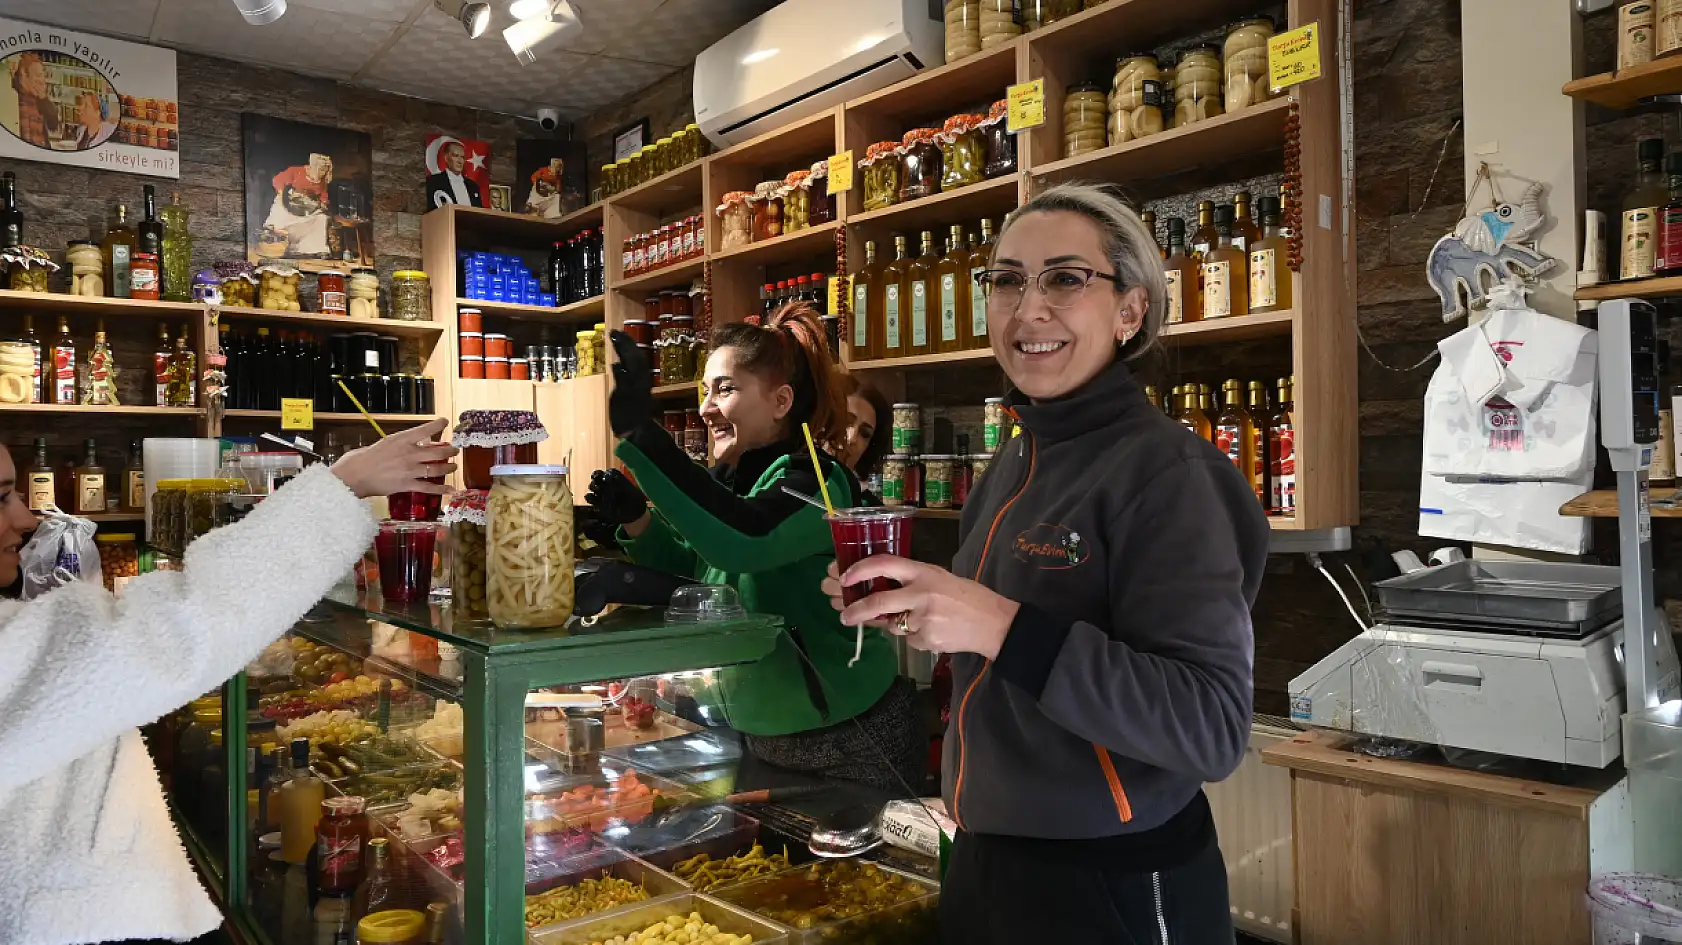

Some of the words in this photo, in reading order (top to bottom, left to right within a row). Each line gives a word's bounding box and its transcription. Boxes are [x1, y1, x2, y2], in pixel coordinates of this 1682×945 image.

[49, 34, 67, 47] mı
[73, 41, 121, 79] yapılır
[98, 149, 148, 169] sirkeyle
[153, 157, 175, 170] mi?
